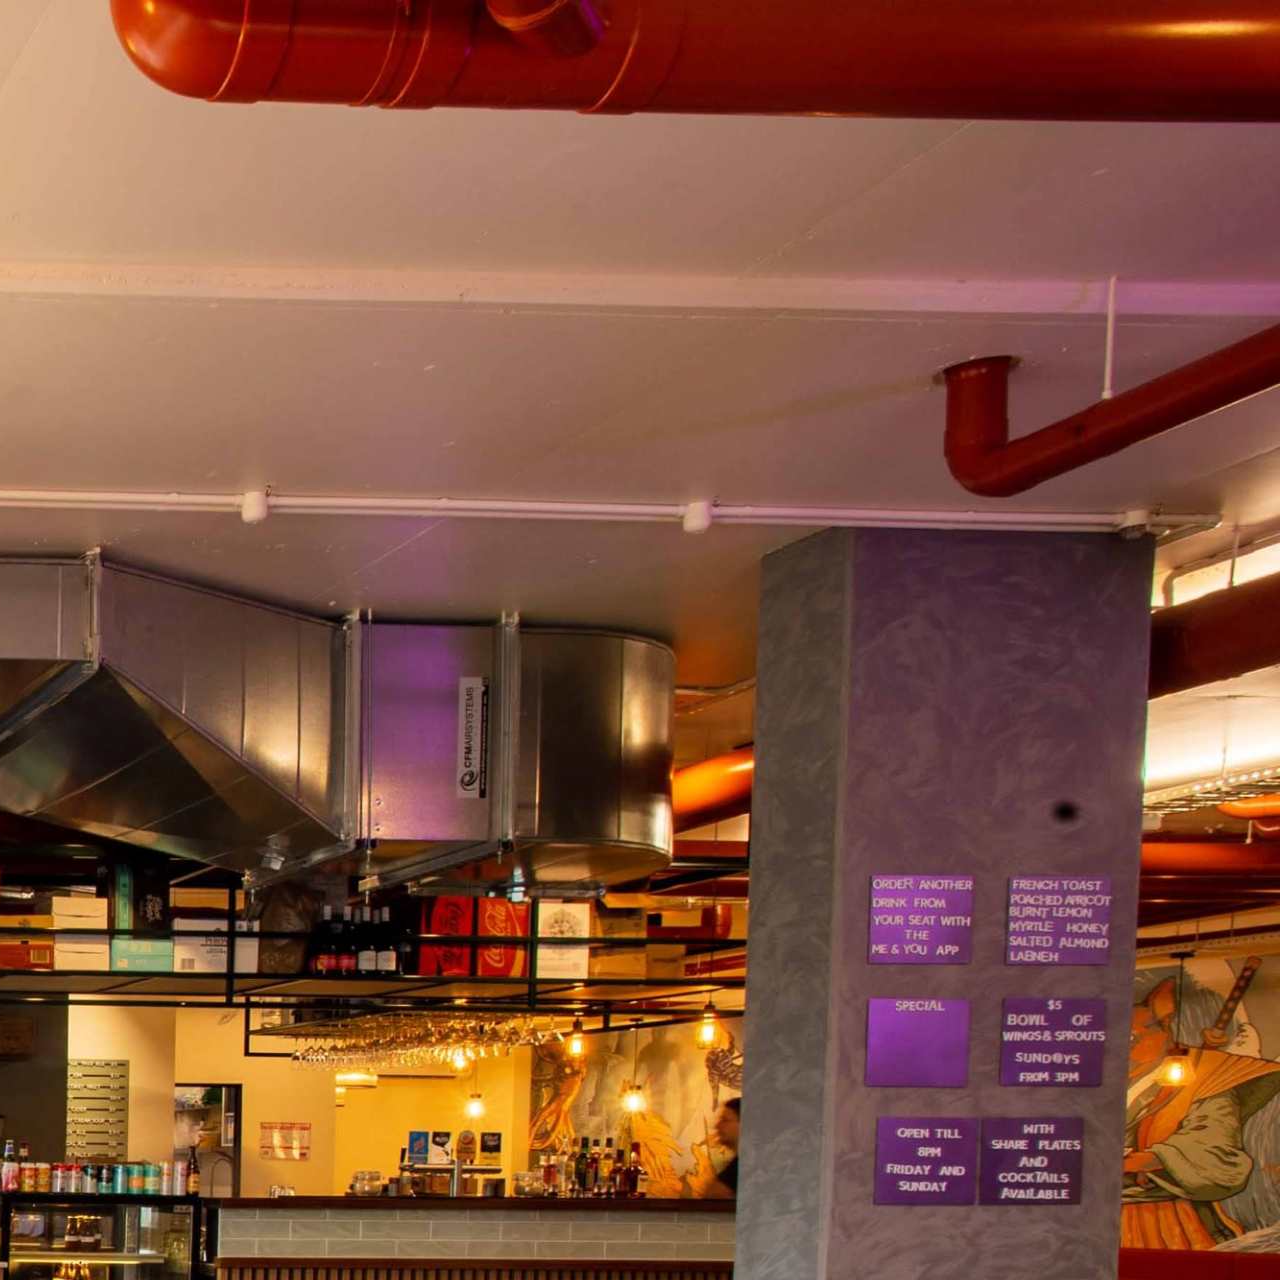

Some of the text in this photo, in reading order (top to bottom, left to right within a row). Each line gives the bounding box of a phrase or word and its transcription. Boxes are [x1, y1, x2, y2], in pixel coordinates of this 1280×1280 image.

[872, 878, 973, 890] ORDER ANOTHER
[1012, 880, 1102, 891] FRENCH TOAST
[872, 898, 946, 908] DRINK FROM
[1010, 894, 1112, 906] POACHED APRICOT
[1008, 906, 1093, 918] BURNT LEMON
[873, 915, 971, 926] YOUR SEAT WITH
[1009, 921, 1109, 935] MYRTLE HONEY
[484, 904, 507, 968] CocCola
[904, 930, 929, 940] THE
[1009, 936, 1109, 948] SALTED ALMOND
[871, 944, 960, 956] ME & YOU APP
[896, 1000, 945, 1011] SPECIAL
[1047, 999, 1062, 1010] $5
[1007, 1014, 1093, 1026] BOWL OF
[1055, 1031, 1106, 1041] SPROUTS
[1019, 1072, 1049, 1082] FROM
[897, 1128, 962, 1138] OPEN TILL
[1023, 1124, 1055, 1134] WITH
[992, 1140, 1081, 1150] SHARE PLATES
[1019, 1156, 1048, 1167] AND
[886, 1164, 966, 1176] FRIDAY AND
[998, 1171, 1069, 1183] COCKTAILS
[898, 1181, 948, 1192] SUNDAY
[1000, 1187, 1070, 1199] AVAILABLE
